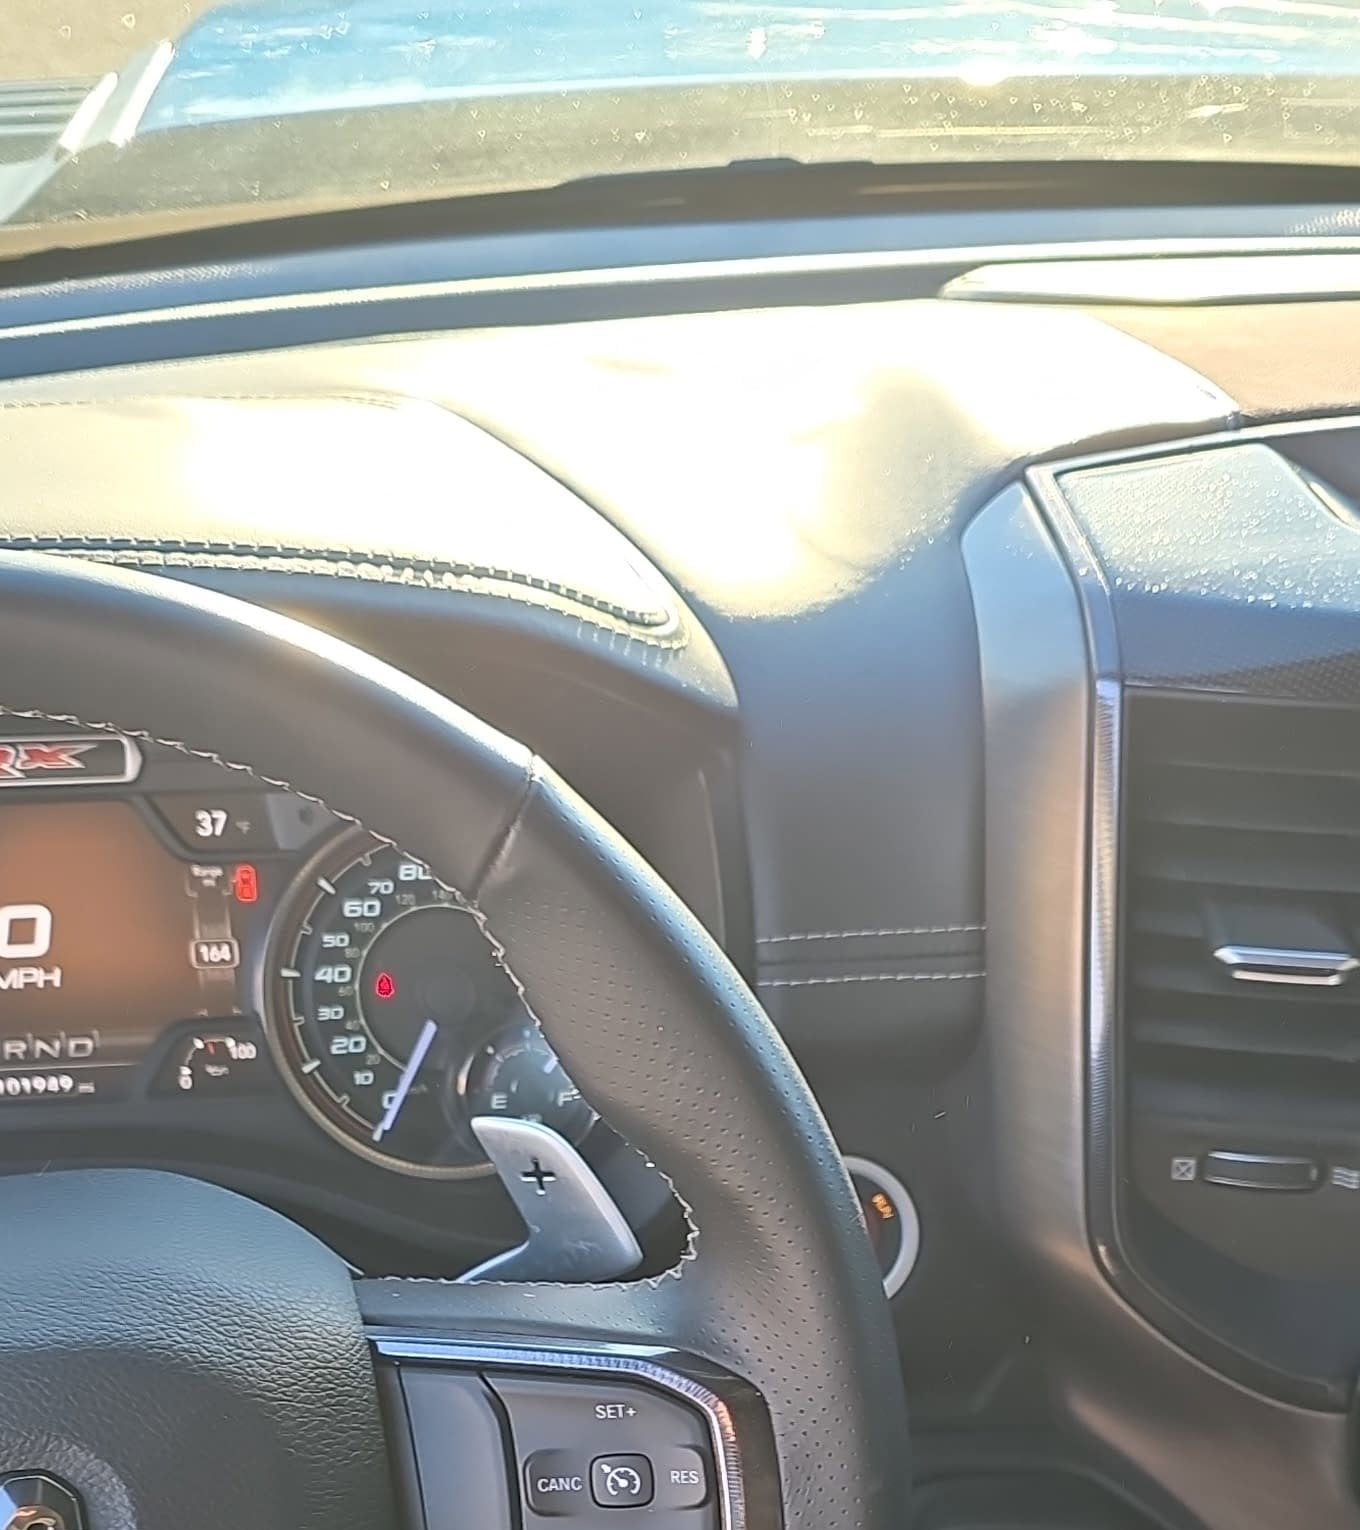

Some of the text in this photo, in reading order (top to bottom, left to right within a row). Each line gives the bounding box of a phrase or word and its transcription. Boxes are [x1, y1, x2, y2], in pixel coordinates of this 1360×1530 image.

[195, 810, 227, 836] 37
[368, 880, 394, 894] 70
[343, 899, 381, 917] 60
[322, 933, 349, 948] 50
[314, 966, 351, 983] 40
[317, 1007, 344, 1020] 30
[330, 1036, 366, 1055] 20
[353, 1071, 374, 1085] 10
[491, 1092, 508, 1109] E
[537, 1477, 583, 1492] CANC
[670, 1470, 699, 1484] RES
